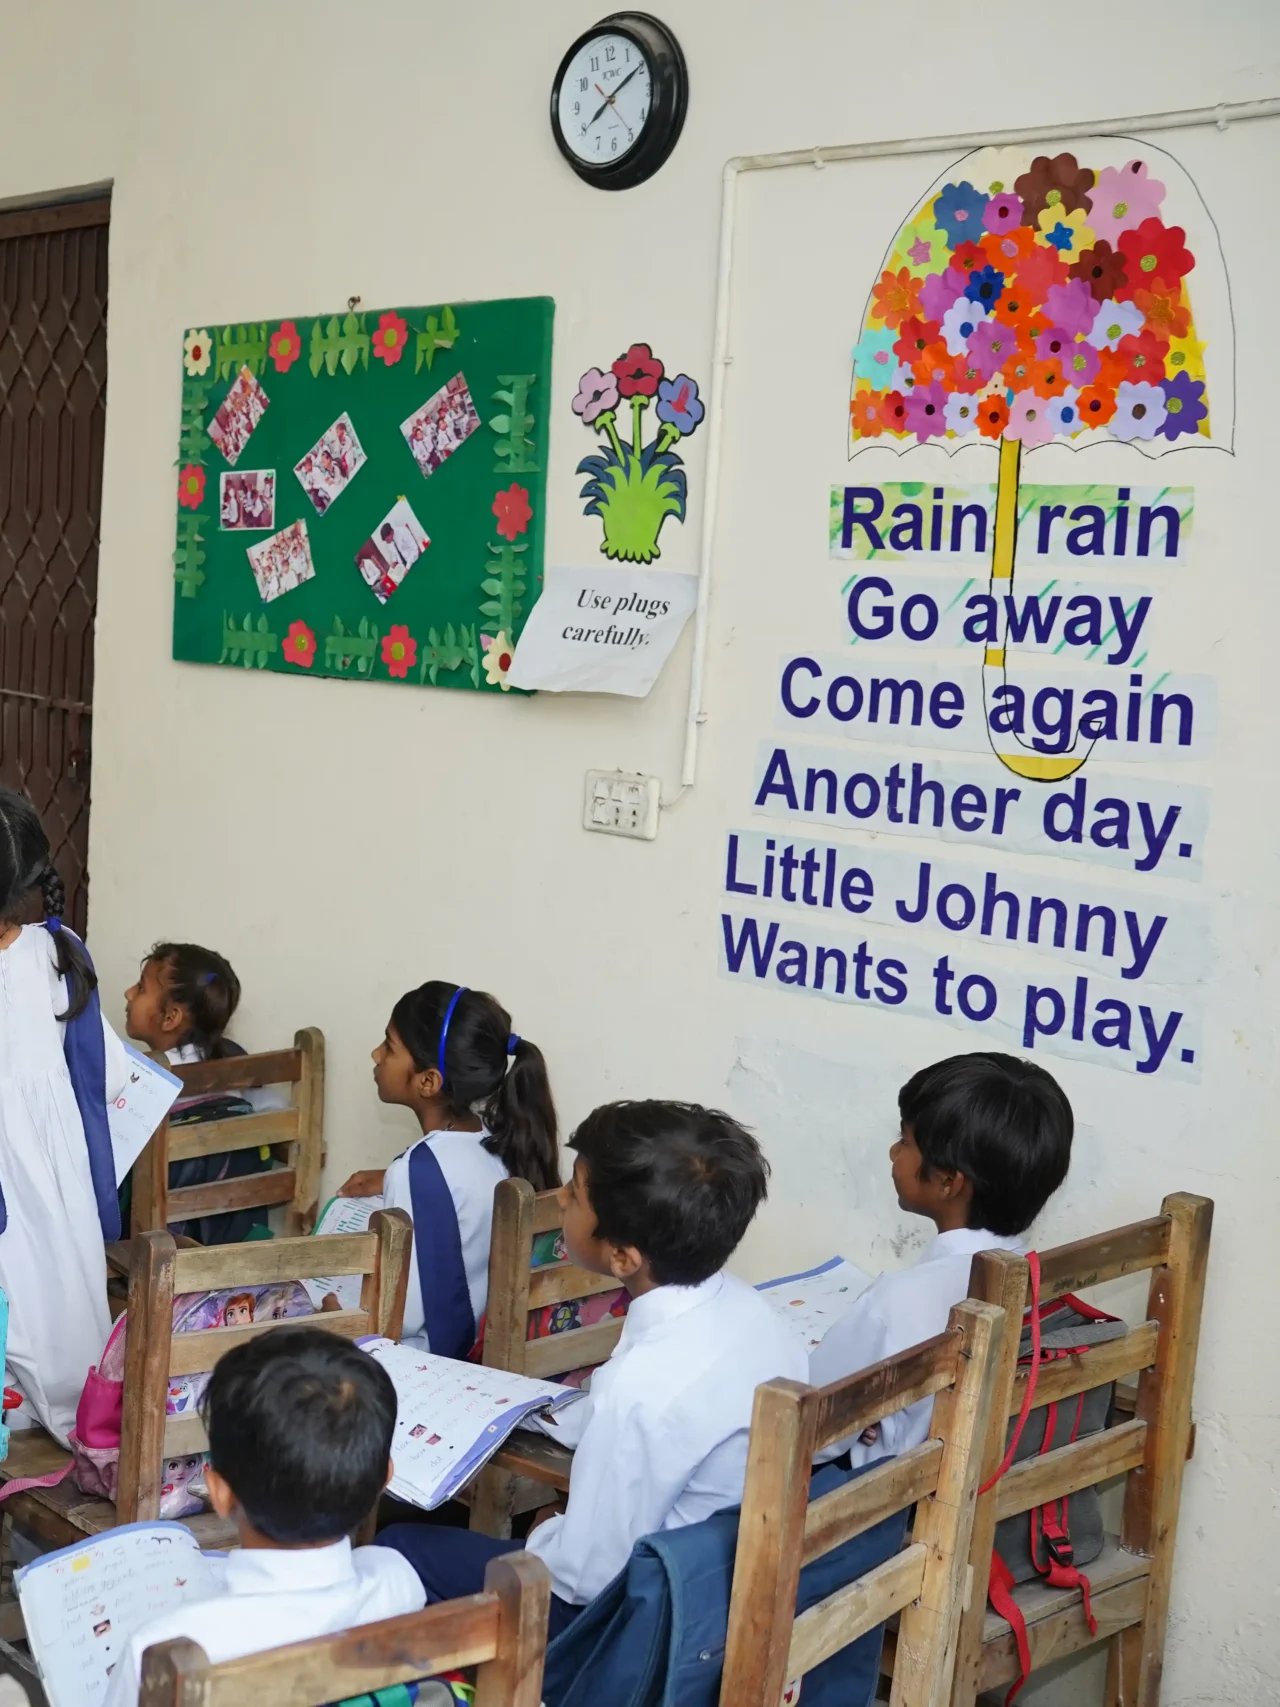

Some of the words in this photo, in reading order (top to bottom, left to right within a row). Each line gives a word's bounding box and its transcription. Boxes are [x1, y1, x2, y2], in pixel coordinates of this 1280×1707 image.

[605, 46, 616, 63] 12
[625, 48, 630, 63] 1
[589, 56, 600, 72] 11
[638, 60, 645, 75] 2
[579, 77, 588, 92] 10
[645, 83, 652, 97] 3
[574, 101, 580, 116] 9
[639, 107, 645, 122] 4
[580, 123, 587, 136] 8
[627, 128, 634, 142] 5
[595, 136, 601, 151] 7
[611, 137, 617, 152] 6
[841, 486, 989, 553] Rain
[1036, 488, 1182, 558] rain
[577, 589, 611, 610] Use
[612, 592, 671, 620] plugs
[847, 577, 939, 642] Go
[962, 593, 1154, 666] away
[562, 625, 650, 650] carefully.
[780, 657, 965, 730] Come
[988, 674, 1194, 755] again
[754, 748, 1022, 836] Another
[1043, 778, 1194, 872] day.
[725, 834, 875, 914] Little
[895, 862, 1169, 981] Johnny
[721, 913, 909, 1006] Wants
[933, 955, 998, 1022] to
[1023, 976, 1195, 1074] play.
